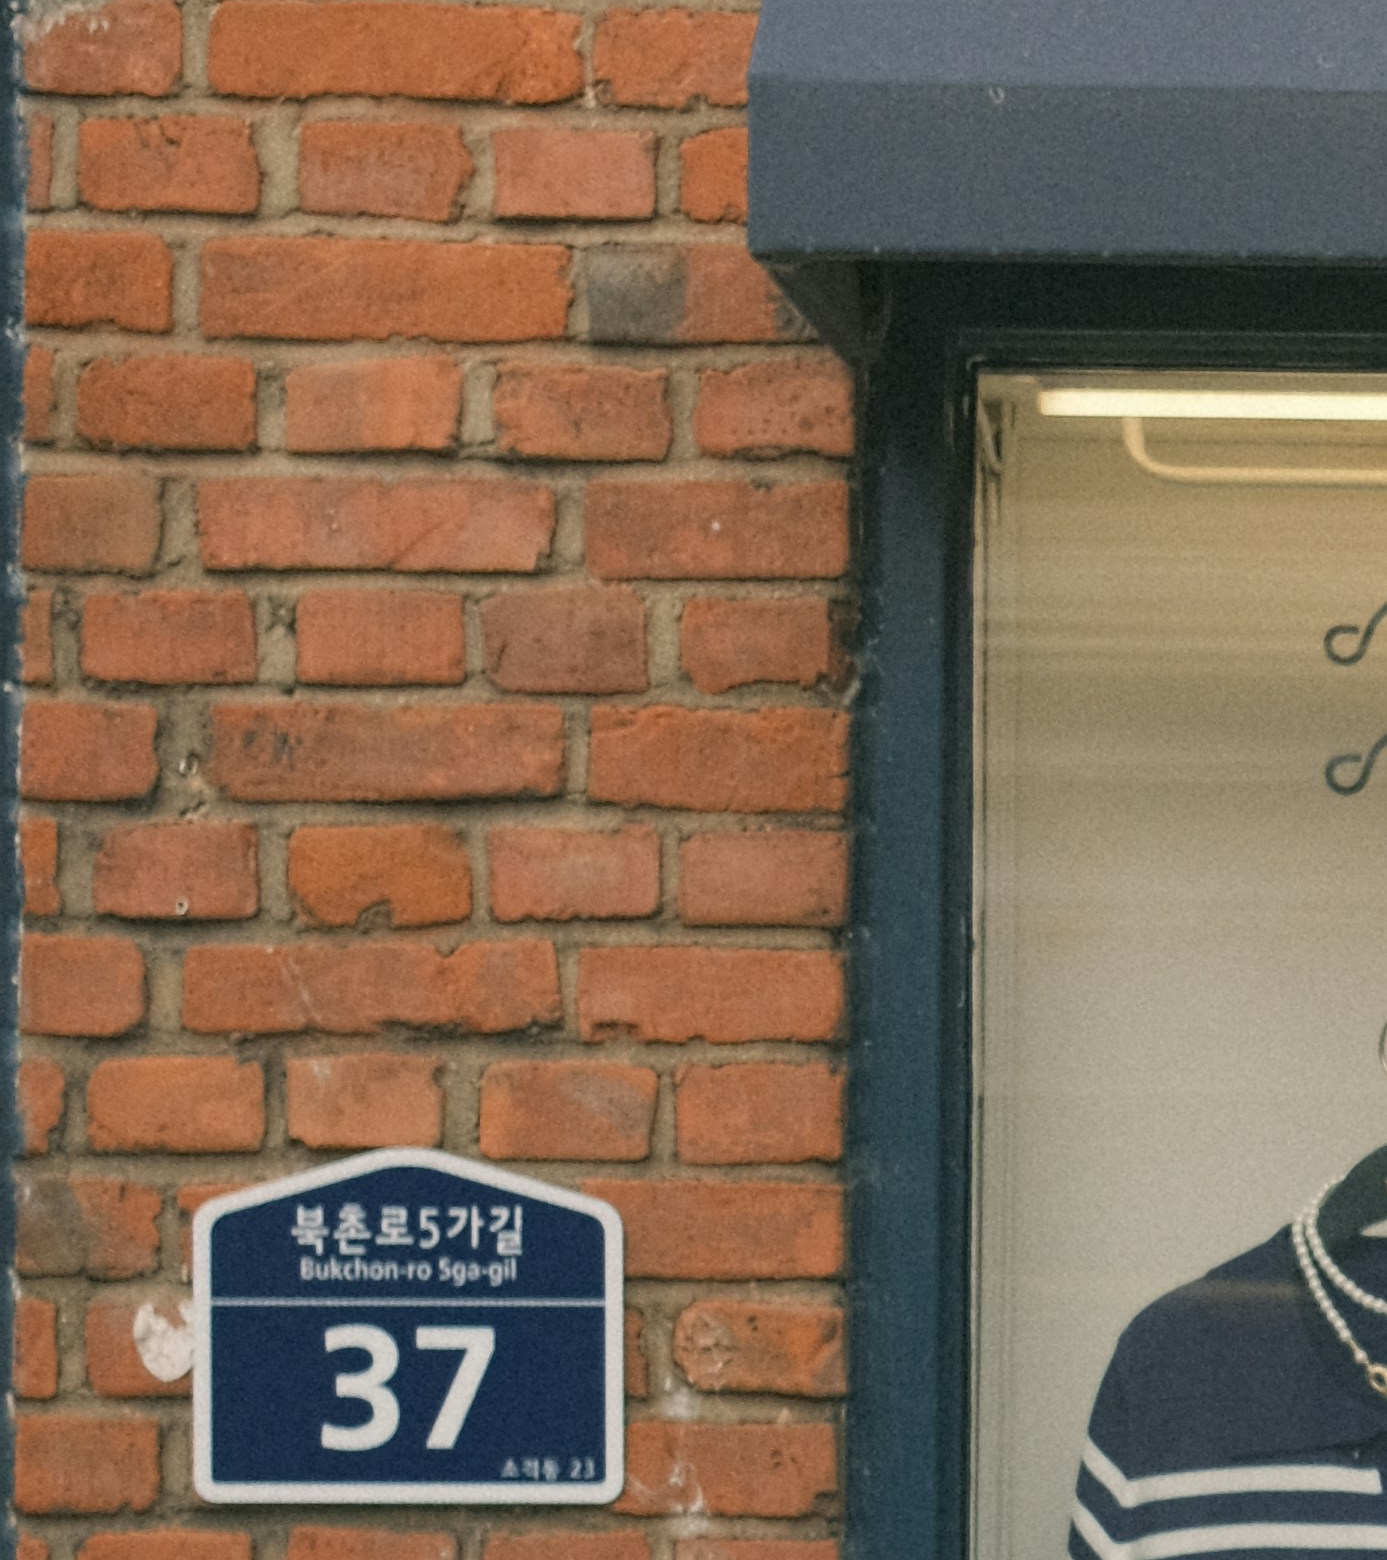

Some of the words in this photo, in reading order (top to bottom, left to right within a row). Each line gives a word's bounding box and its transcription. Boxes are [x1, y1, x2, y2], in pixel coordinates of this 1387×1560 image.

[290, 1202, 524, 1257] 북촌로5가길
[299, 1257, 431, 1282] Bukchon-ro
[438, 1257, 518, 1287] 5ga-gil
[320, 1322, 497, 1452] 37
[569, 1456, 596, 1480] 23
